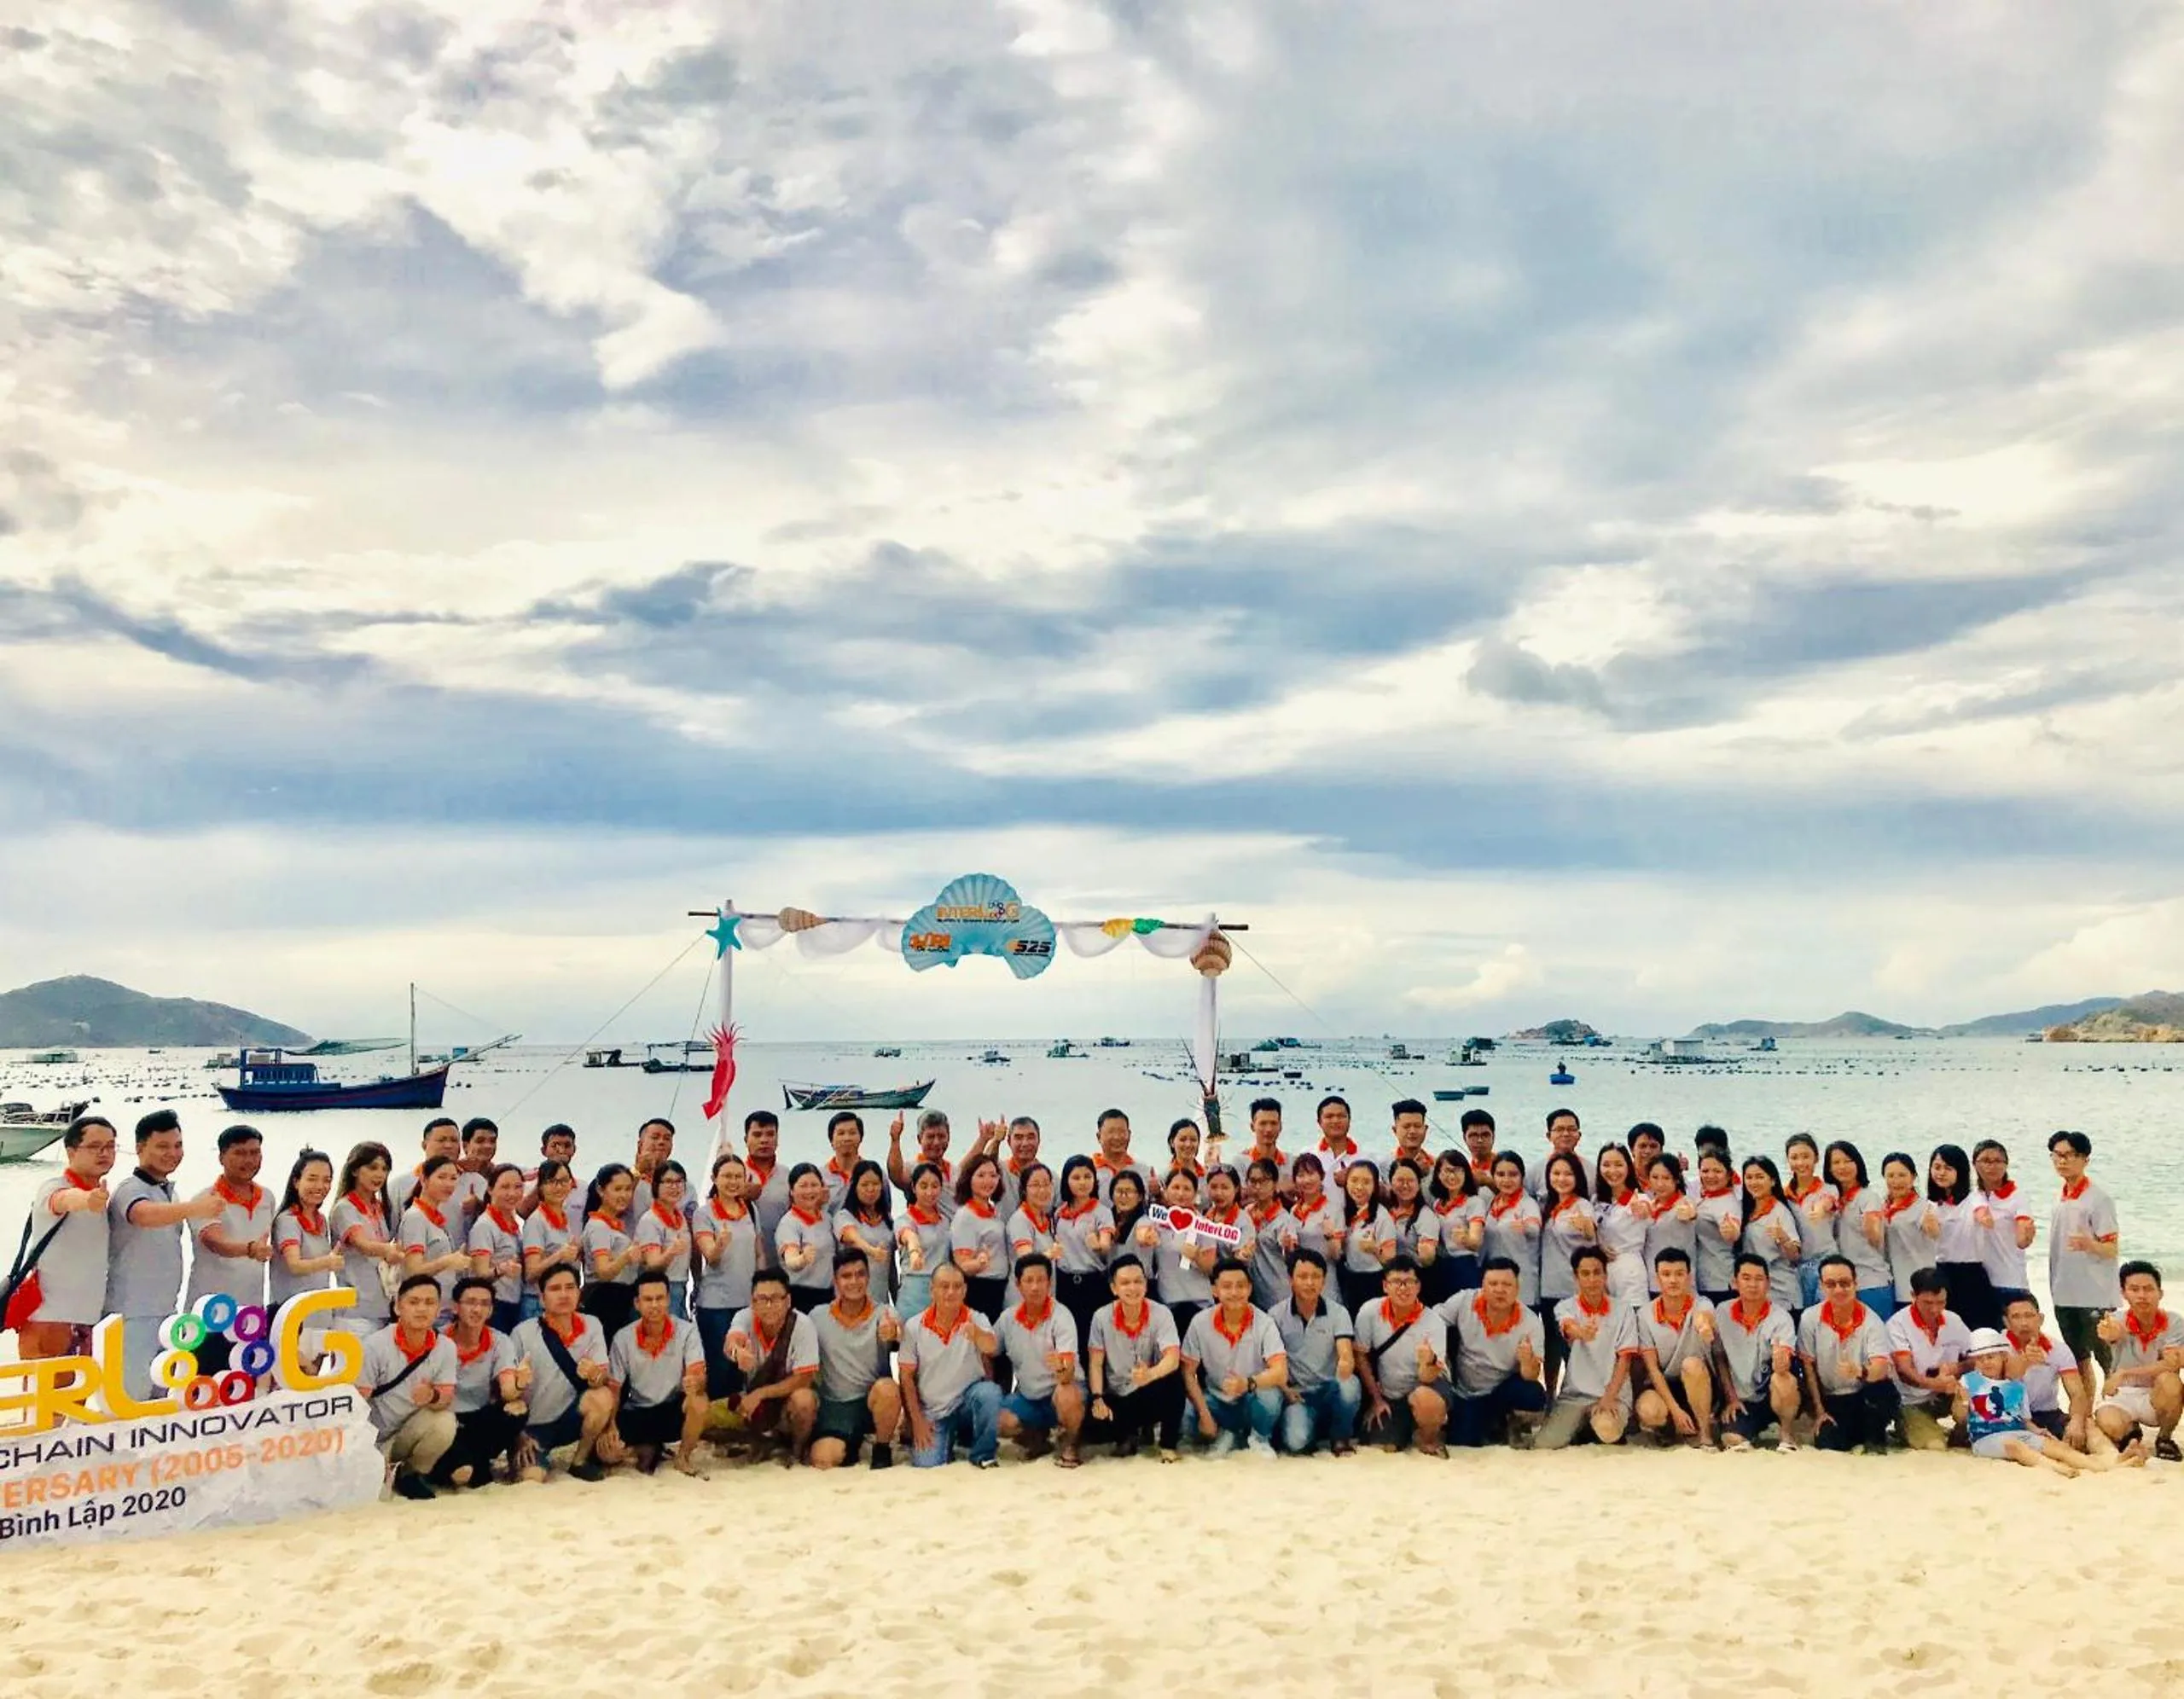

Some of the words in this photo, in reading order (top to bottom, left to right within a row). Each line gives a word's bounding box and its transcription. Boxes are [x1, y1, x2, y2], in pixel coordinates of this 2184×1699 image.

[131, 1395, 354, 1449] INNOVATOR
[0, 1509, 60, 1540] Bình
[68, 1497, 116, 1530] Lập
[122, 1486, 186, 1516] 2020
[3, 1462, 141, 1510] ERSARY
